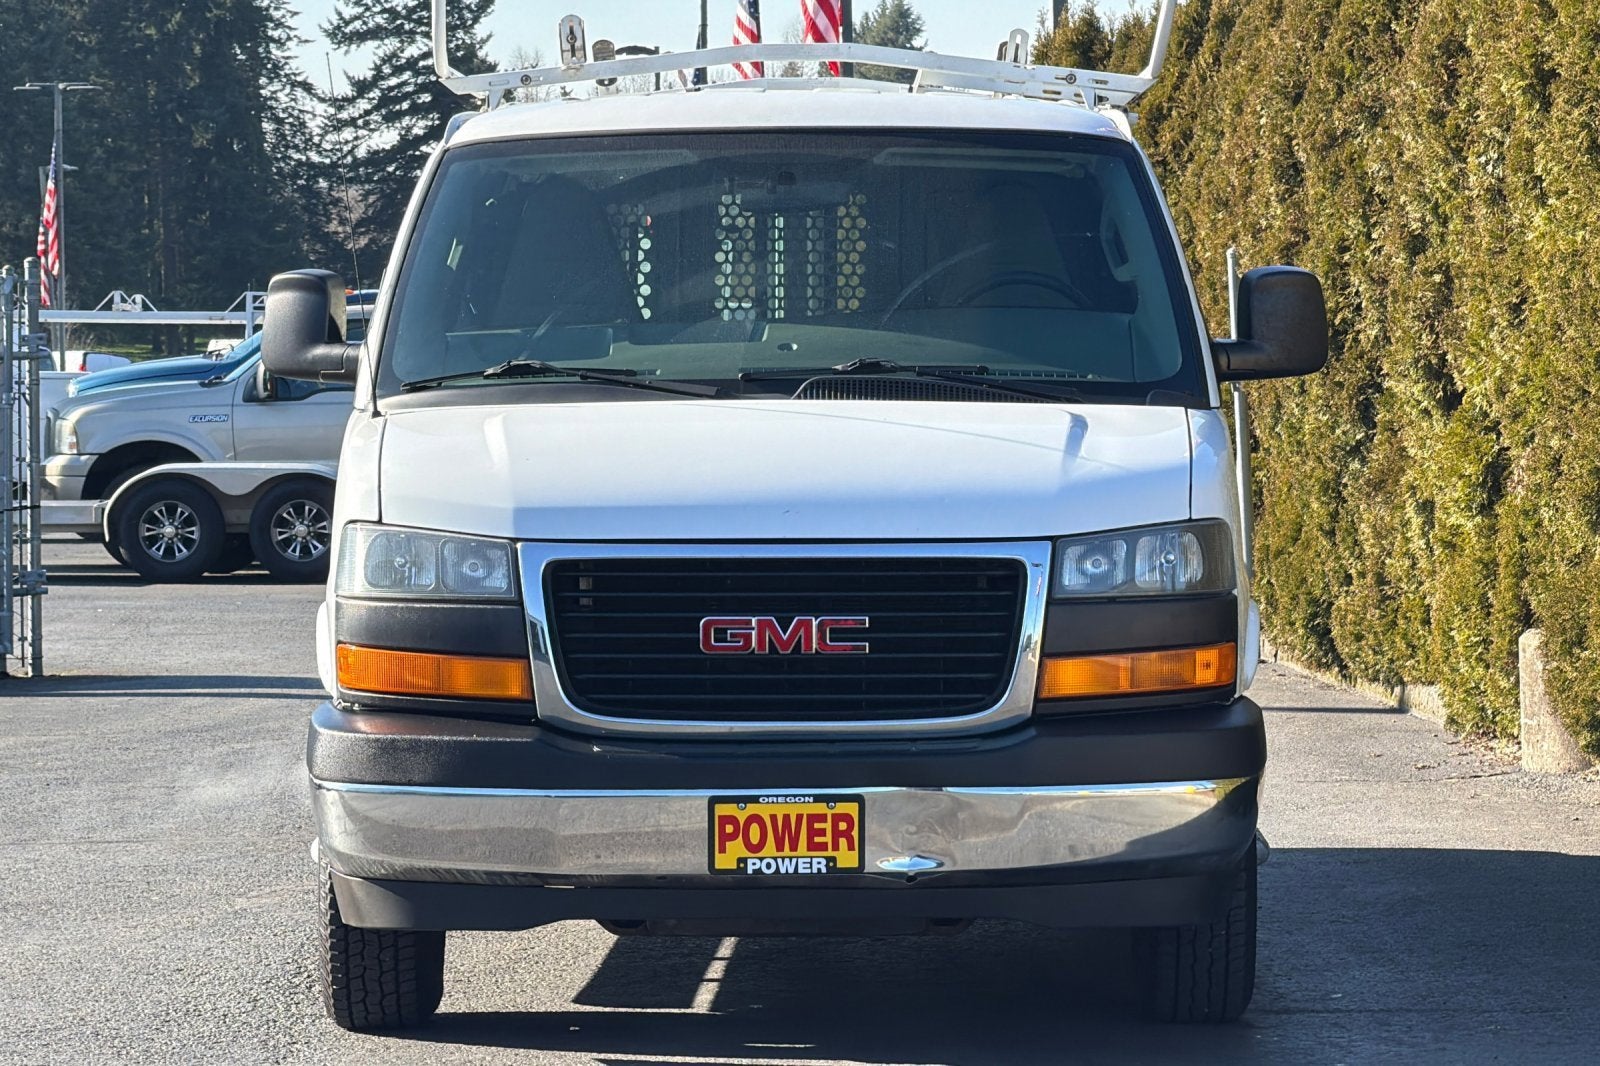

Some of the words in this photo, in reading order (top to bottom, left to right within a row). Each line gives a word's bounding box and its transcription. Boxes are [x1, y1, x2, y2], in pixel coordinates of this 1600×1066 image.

[189, 414, 229, 423] EXCURSION
[700, 616, 869, 654] GMC
[717, 812, 856, 855] POWER
[746, 857, 827, 875] POWER
